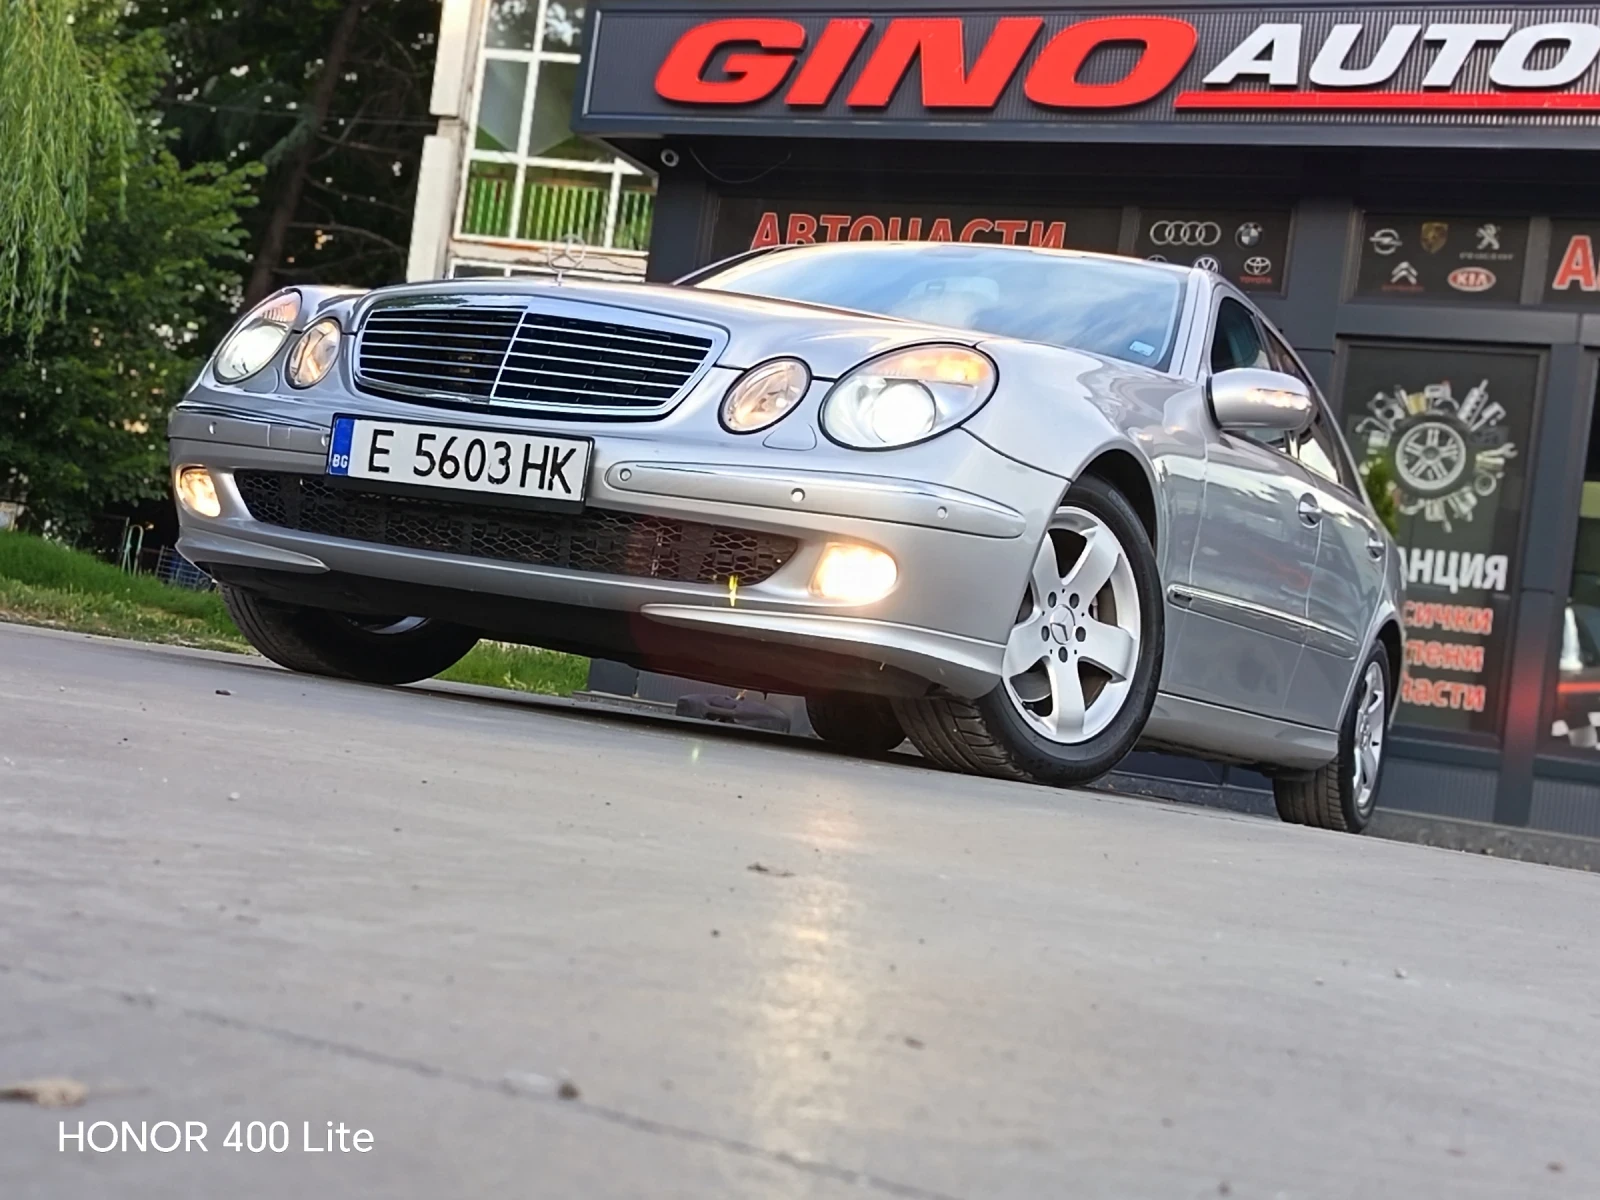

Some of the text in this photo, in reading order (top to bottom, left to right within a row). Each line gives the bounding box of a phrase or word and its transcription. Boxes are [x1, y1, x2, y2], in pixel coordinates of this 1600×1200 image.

[655, 16, 1600, 108] GINO AUTO
[1456, 272, 1489, 287] KIA
[1552, 235, 1600, 291] А
[332, 453, 348, 468] BG
